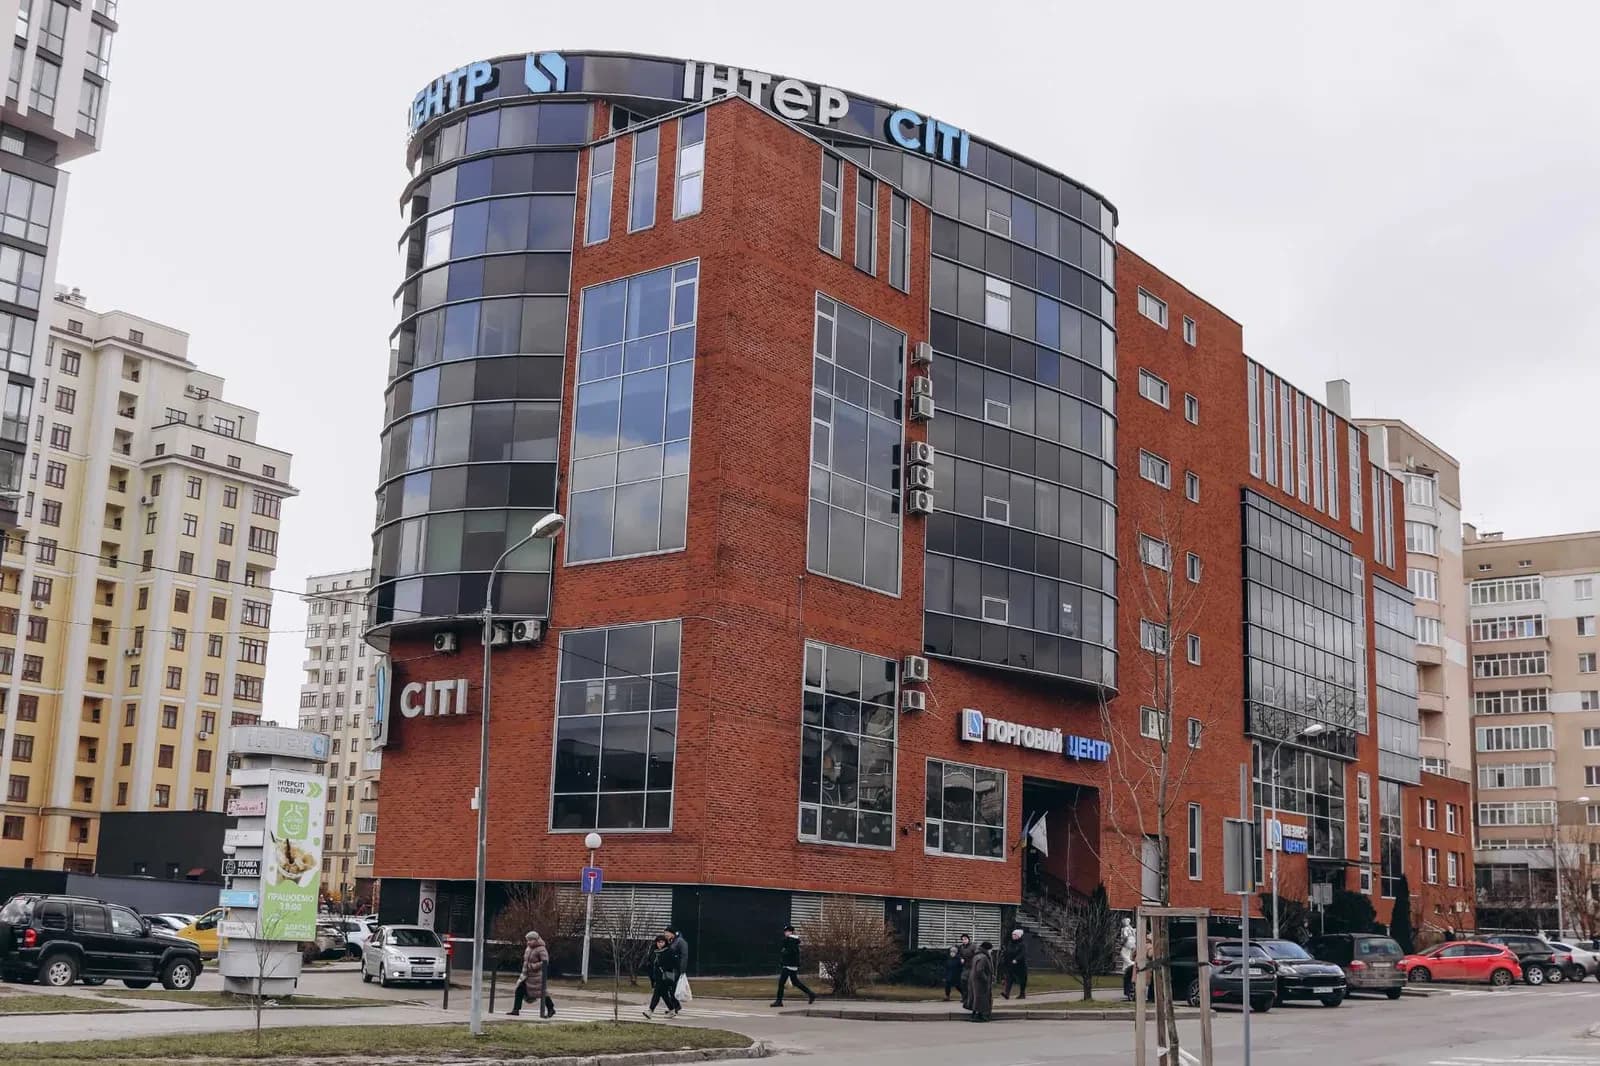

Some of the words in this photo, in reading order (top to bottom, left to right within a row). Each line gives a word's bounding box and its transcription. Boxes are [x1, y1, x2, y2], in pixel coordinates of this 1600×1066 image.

[409, 61, 492, 130] ЕНТР
[985, 717, 1063, 753] ТОРГОВИЙ
[1067, 735, 1111, 762] ЦЕНТР
